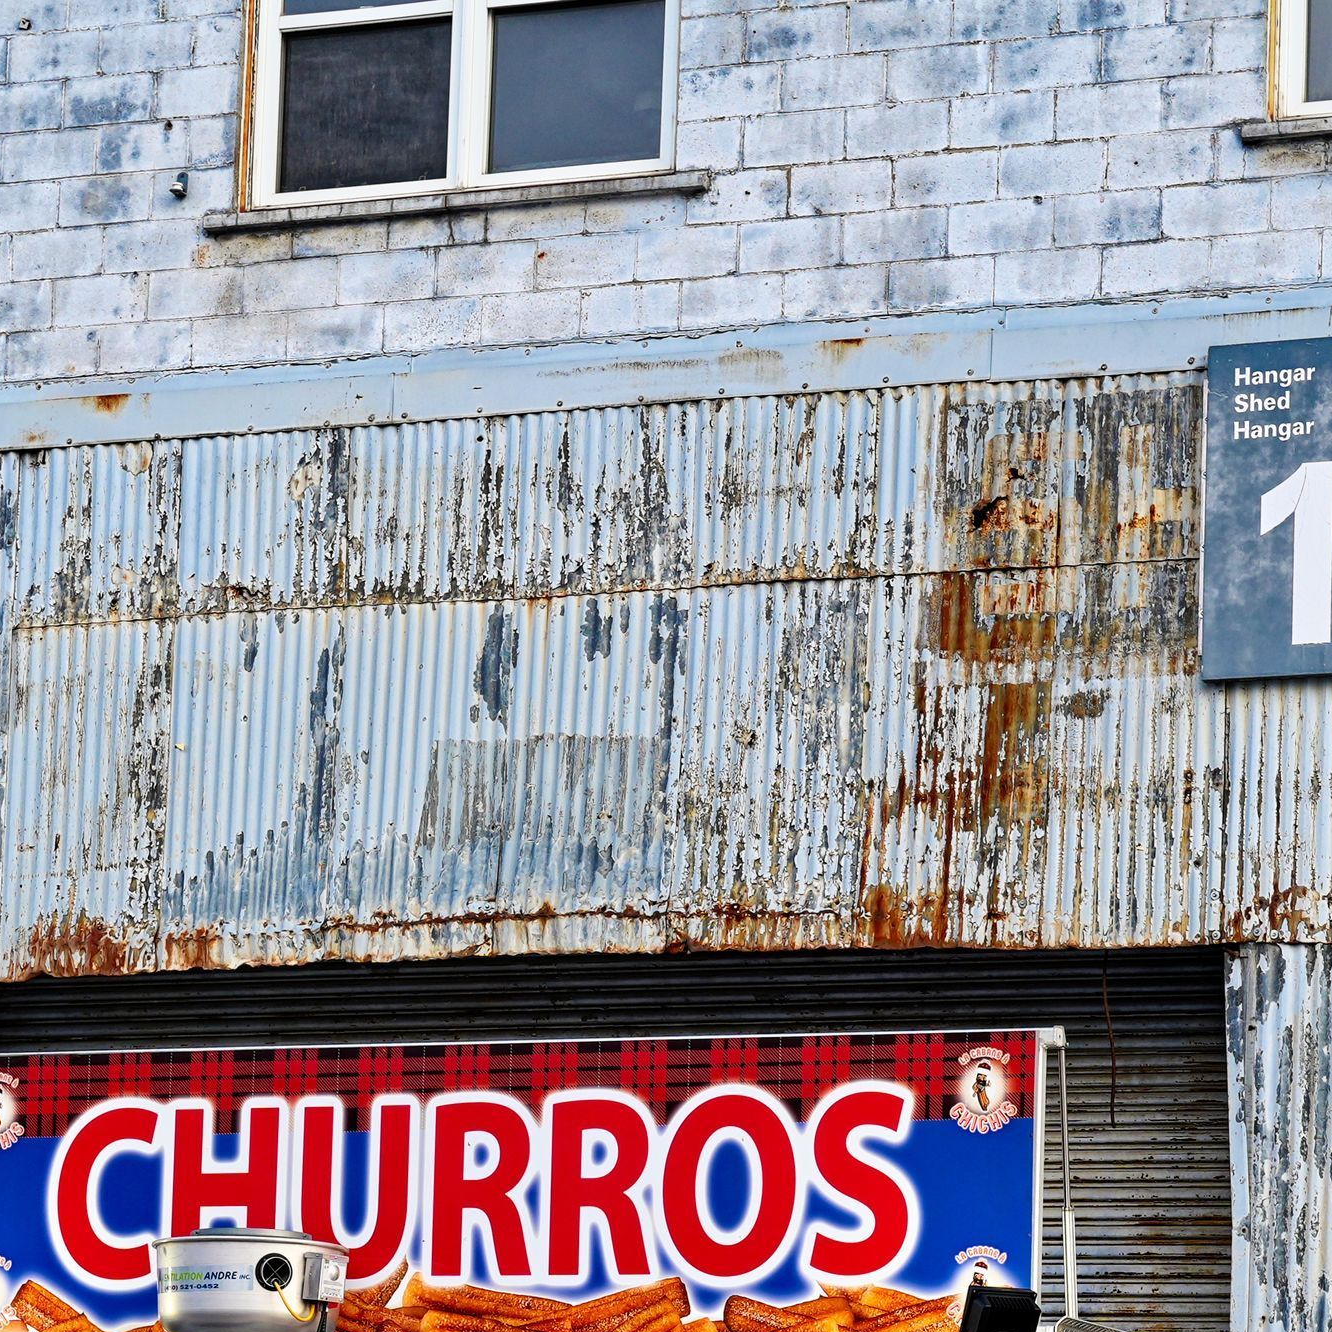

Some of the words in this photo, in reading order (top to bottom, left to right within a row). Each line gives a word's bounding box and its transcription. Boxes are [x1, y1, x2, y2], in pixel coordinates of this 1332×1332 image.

[1234, 365, 1316, 387] Hangar
[1234, 391, 1291, 413] Shed
[1233, 418, 1315, 441] Hangar
[950, 1101, 1017, 1134] CHICHIS
[51, 1084, 918, 1286] CHURROS
[204, 1271, 237, 1280] ANDRE
